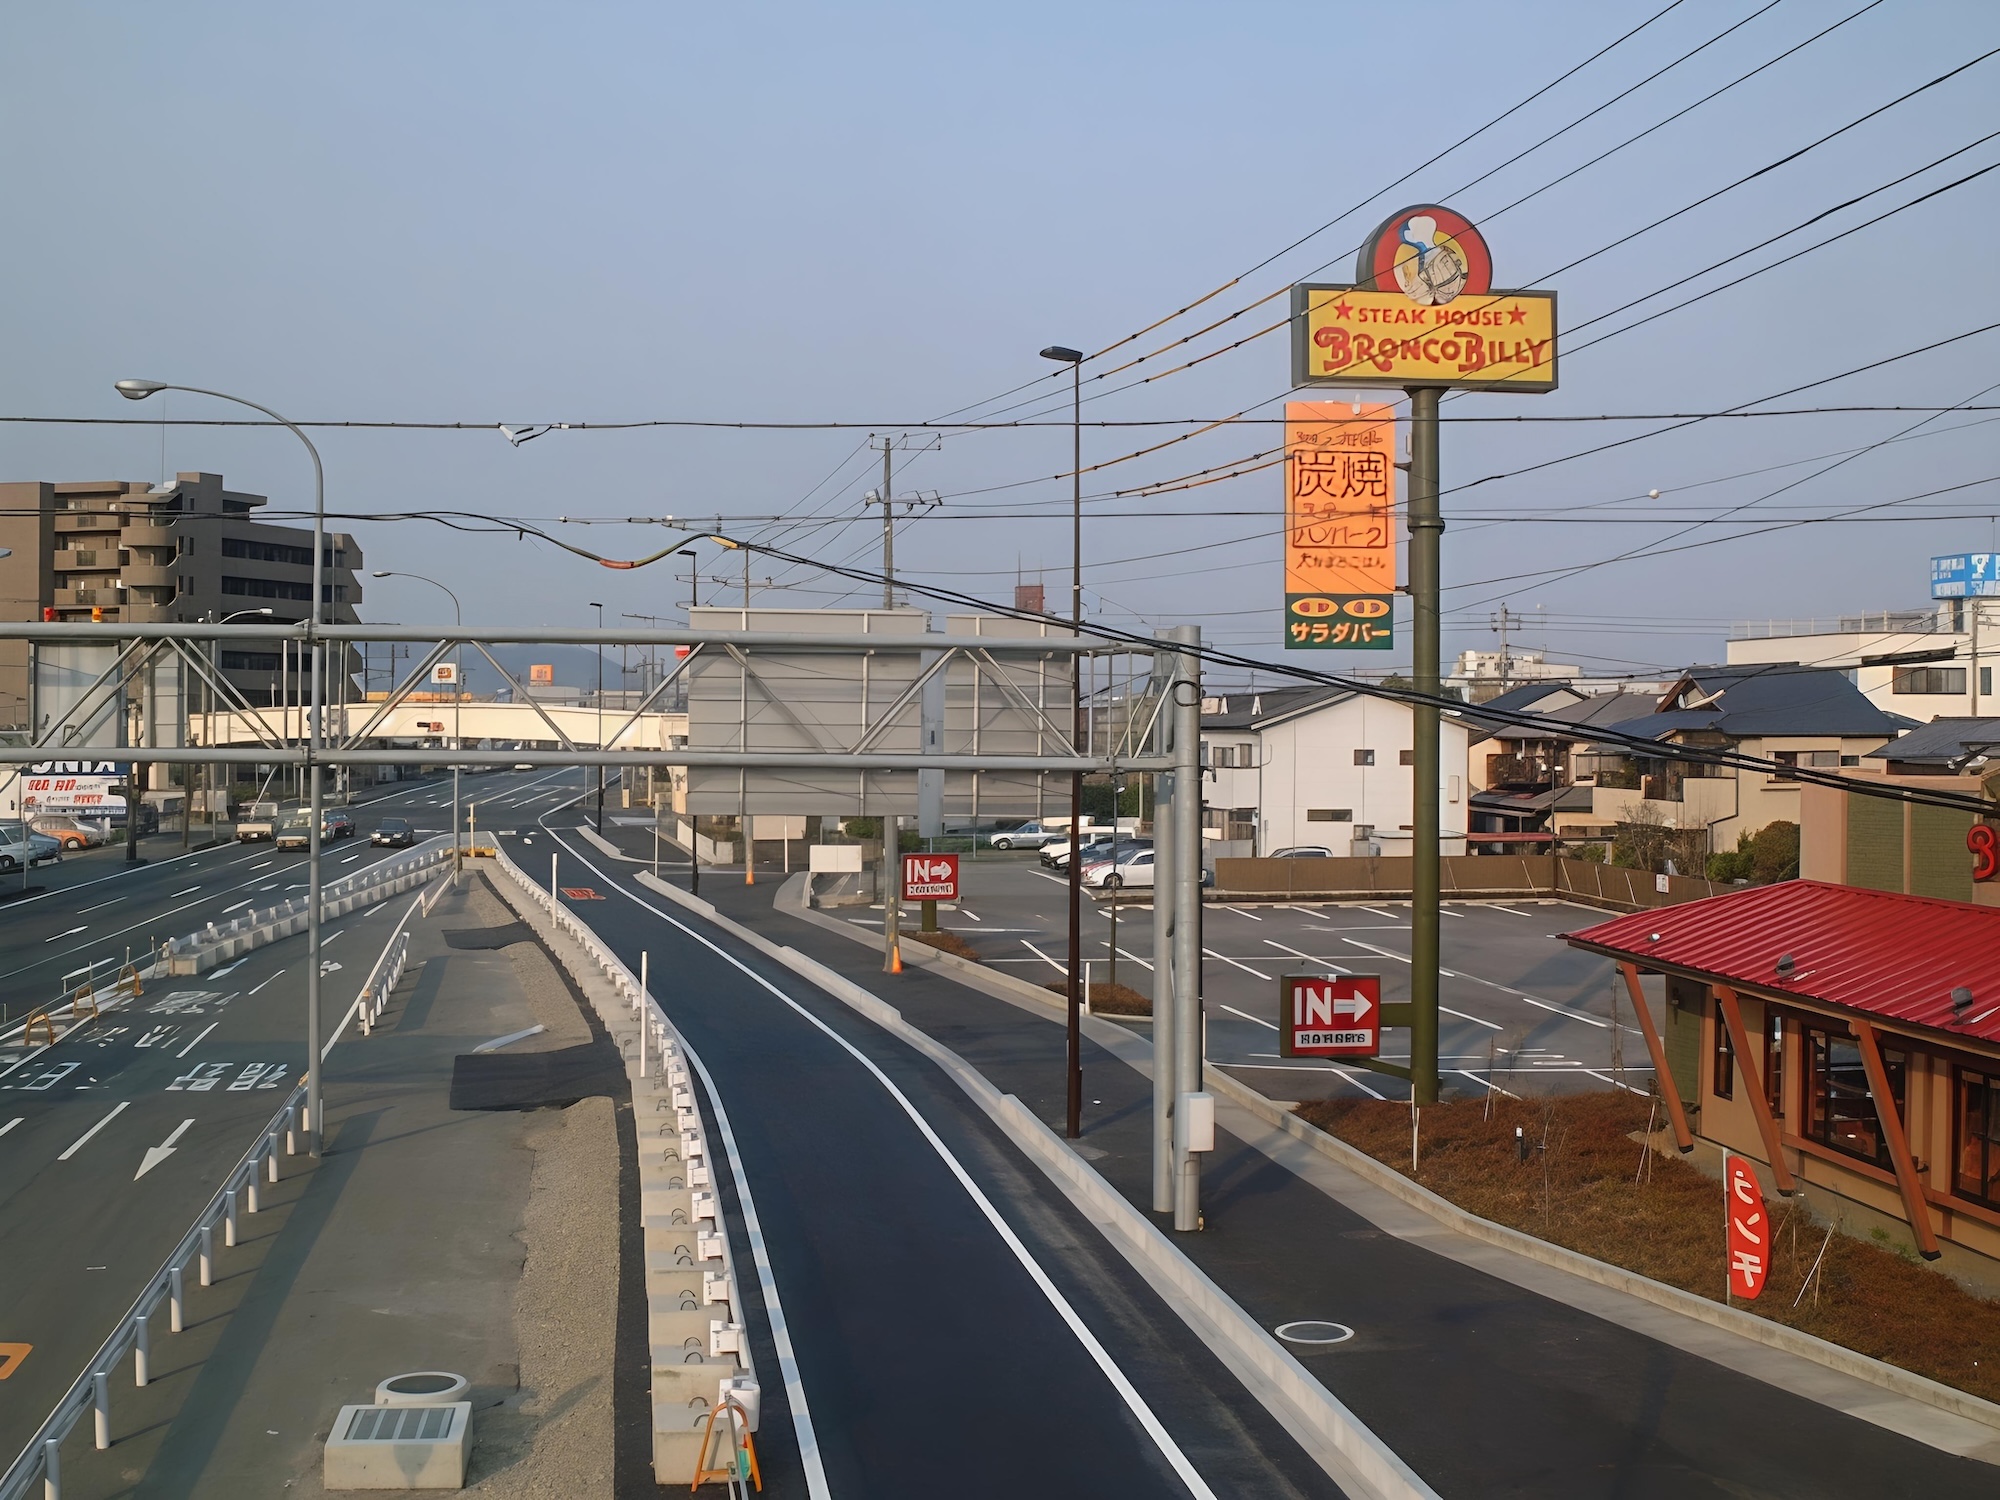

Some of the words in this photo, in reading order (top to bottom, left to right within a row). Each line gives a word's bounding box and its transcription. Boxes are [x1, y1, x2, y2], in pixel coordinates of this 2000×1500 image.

[1358, 307, 1426, 325] STEAK
[1434, 308, 1503, 326] HOUSE
[1296, 454, 1388, 499] 炭焼
[1290, 621, 1391, 643] サラダバー
[906, 858, 931, 883] IN
[1294, 986, 1332, 1026] IN
